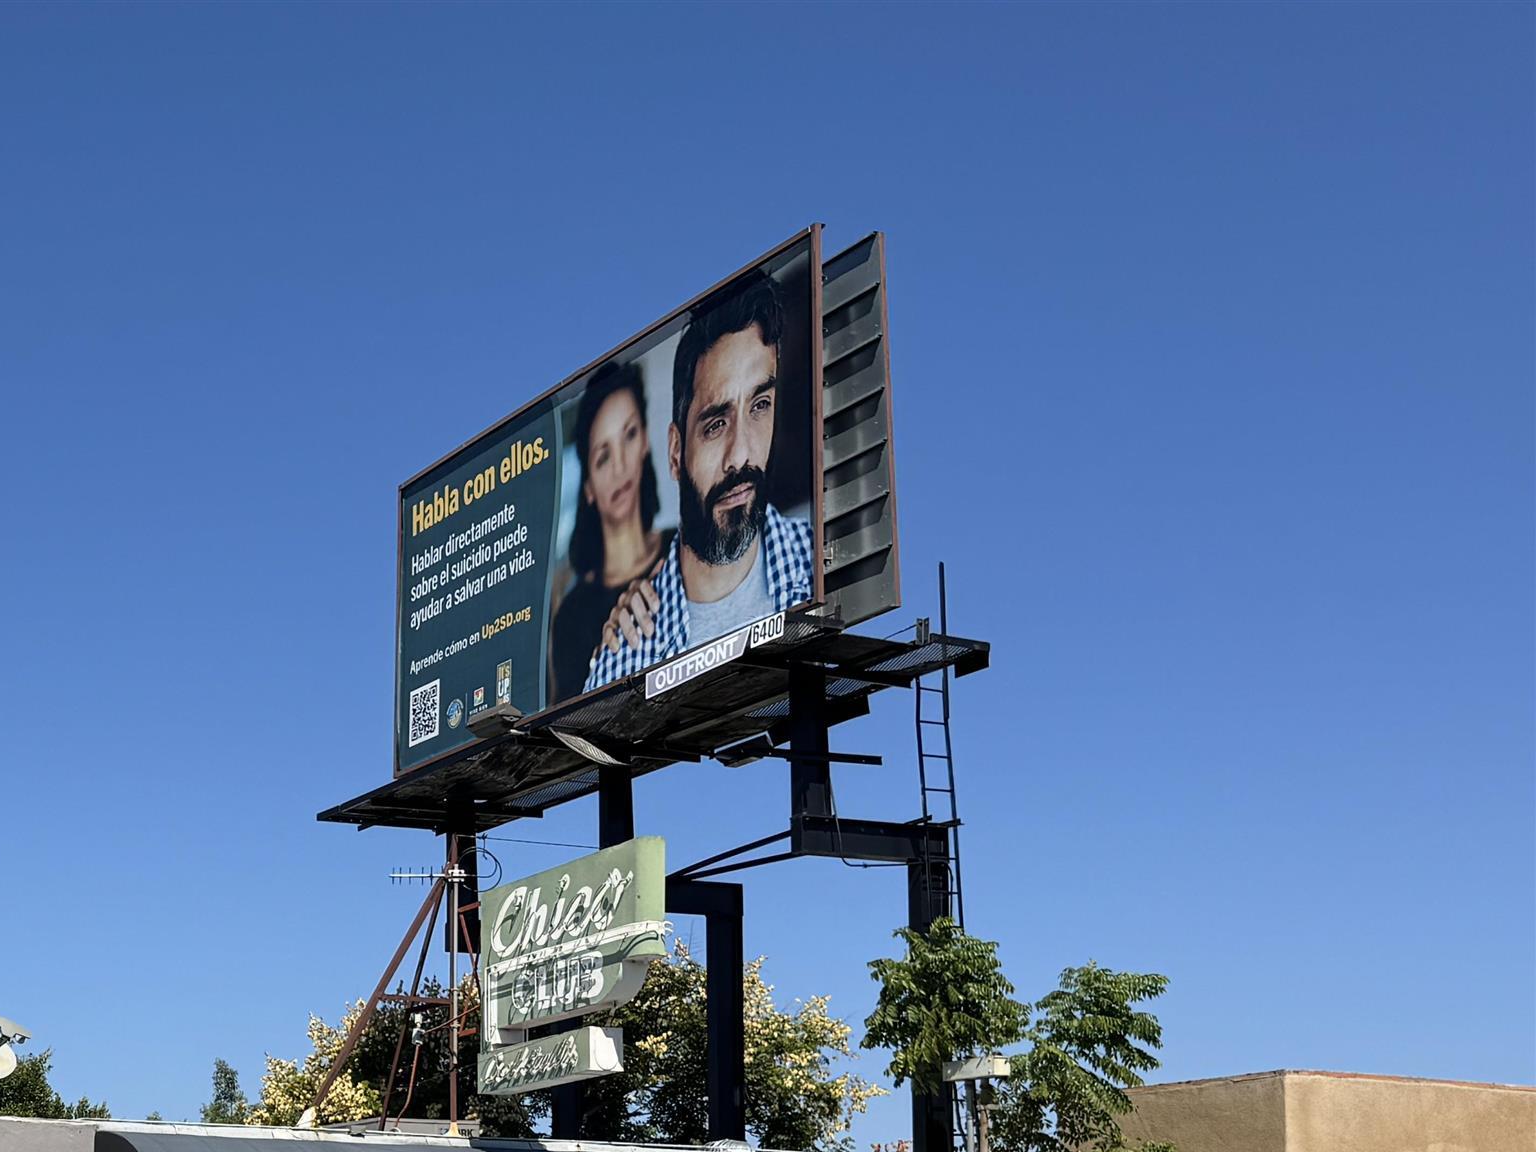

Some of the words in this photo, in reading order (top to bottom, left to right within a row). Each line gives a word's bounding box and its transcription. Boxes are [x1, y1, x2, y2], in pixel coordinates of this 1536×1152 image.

[412, 485, 460, 537] Habla
[464, 465, 496, 506] con
[500, 437, 550, 484] ellos.
[410, 575, 438, 602] sobre
[440, 567, 449, 587] el
[451, 545, 491, 578] suicidio
[493, 523, 528, 562] puede
[411, 544, 444, 576] Hablar
[445, 503, 515, 556] directamente
[410, 597, 444, 630] ayudar
[446, 595, 452, 609] a
[454, 575, 485, 605] salvar
[487, 564, 507, 588] una
[509, 549, 536, 577] vida.
[409, 648, 444, 675] Aprende
[444, 638, 468, 658] cómo
[469, 631, 480, 645] en
[481, 606, 532, 640] Up2SD.org
[654, 635, 739, 690] OUTFRONT
[752, 616, 783, 644] 6400
[512, 951, 604, 1014] CLUB
